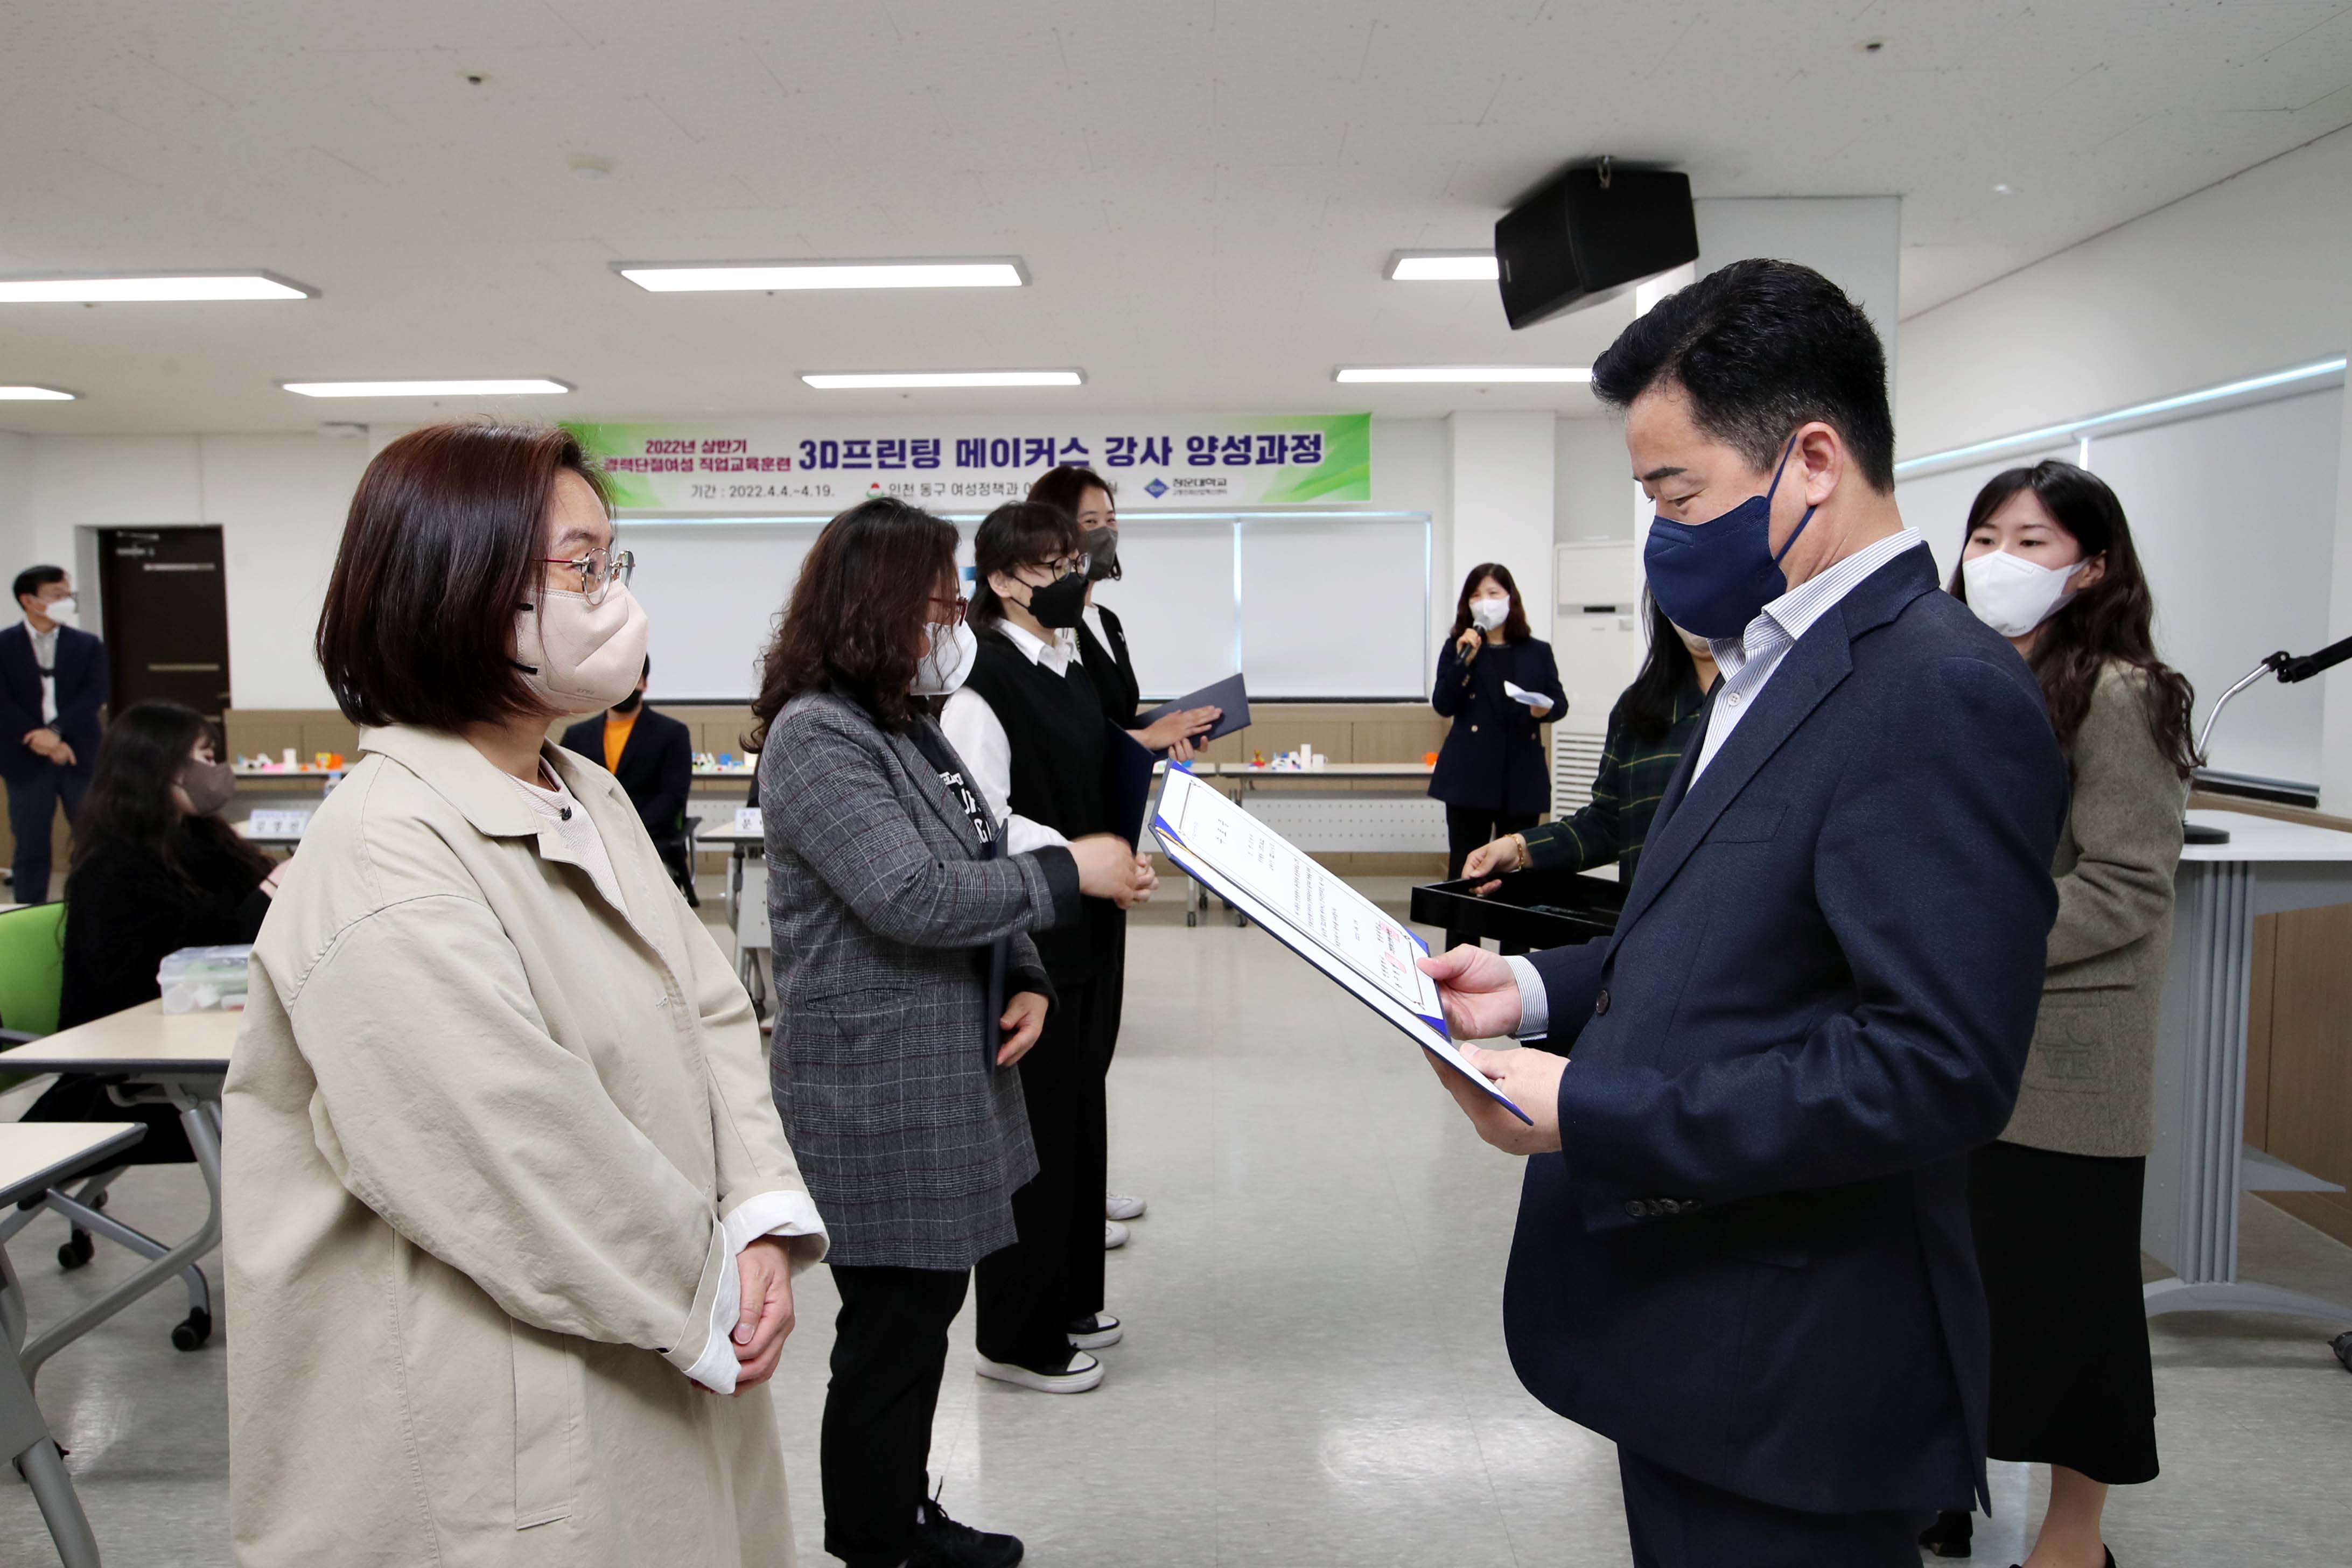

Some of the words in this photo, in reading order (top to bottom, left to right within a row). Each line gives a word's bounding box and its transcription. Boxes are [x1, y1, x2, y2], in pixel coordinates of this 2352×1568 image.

[646, 440, 695, 454] 2022년
[702, 439, 747, 453] 상반기
[799, 438, 941, 470] 3D프린팅
[956, 437, 1089, 468] 메이커스
[1105, 436, 1173, 467] 강사
[1186, 433, 1321, 466] 양성과정
[699, 457, 791, 472] 직업교육훈련
[691, 485, 716, 499] 기간
[730, 485, 835, 498] 2022.4.4.~4.19.
[889, 482, 914, 497] 인천
[920, 482, 946, 496] 동구
[951, 482, 1018, 496] 여성정책과
